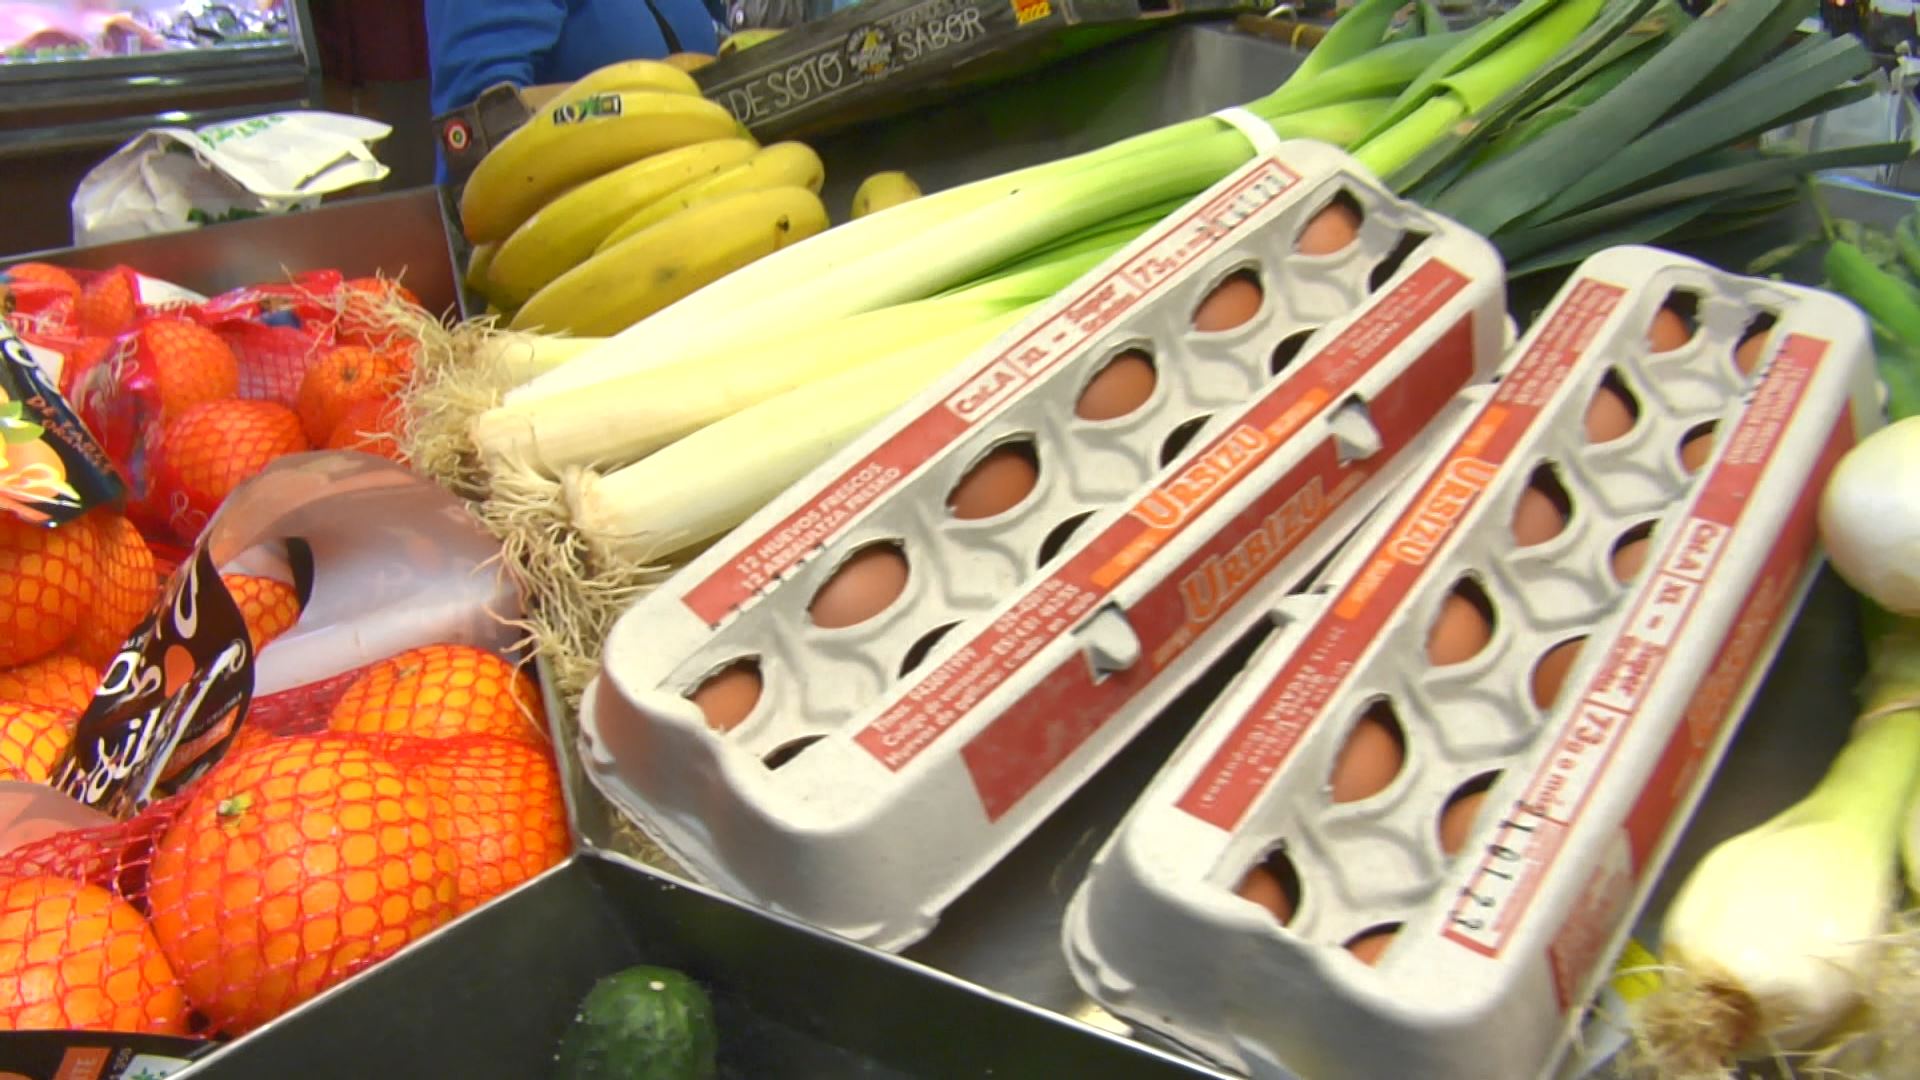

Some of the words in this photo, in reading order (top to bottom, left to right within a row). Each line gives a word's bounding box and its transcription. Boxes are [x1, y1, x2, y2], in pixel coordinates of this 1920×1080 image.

[728, 83, 769, 122] DE
[767, 51, 844, 109] SOTO
[898, 7, 986, 61] SABOR
[755, 508, 823, 560] HUEVOS
[815, 460, 885, 513] FRESCOS
[1127, 419, 1276, 536] URBIZU
[1380, 452, 1501, 568] URBIZU
[1177, 462, 1323, 635] URBIZU
